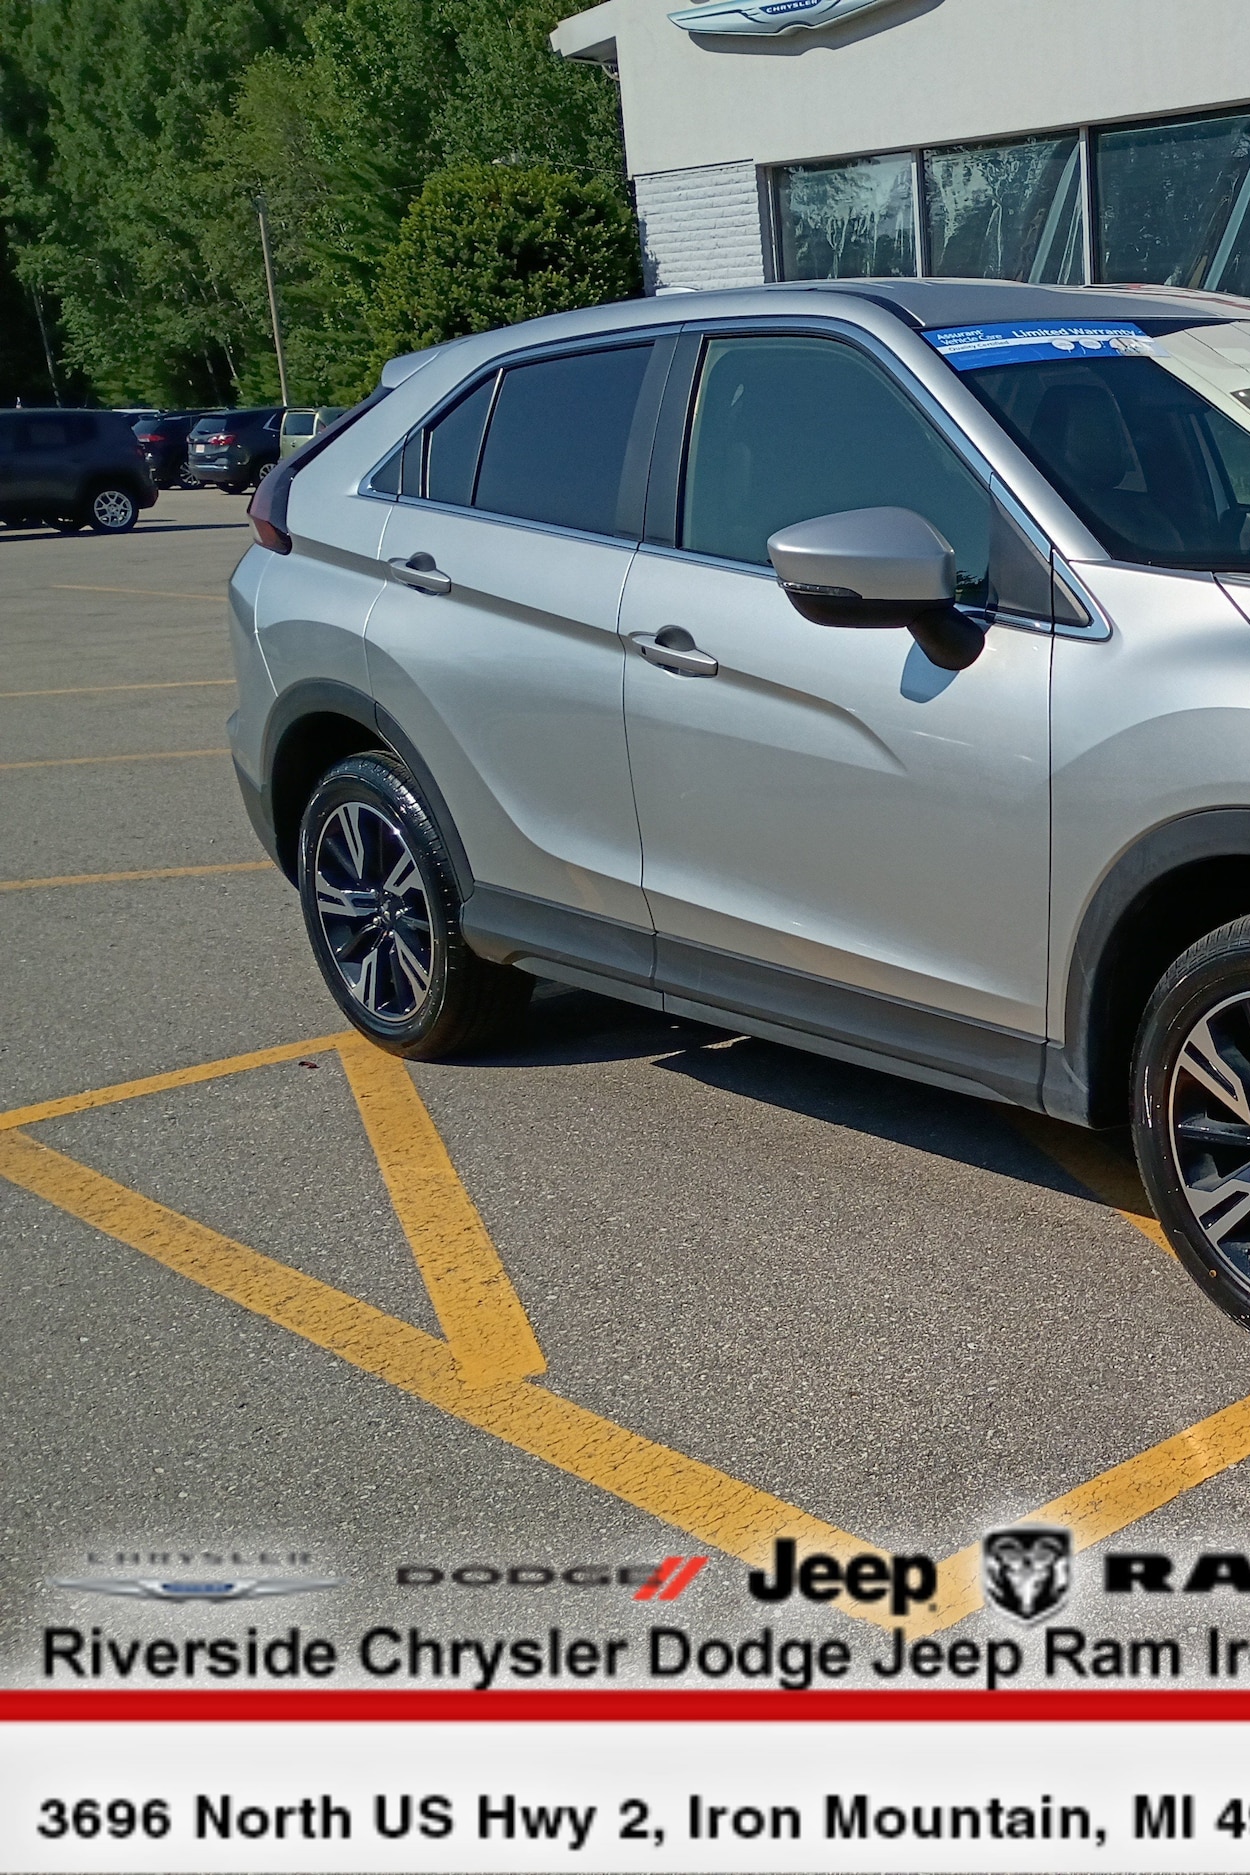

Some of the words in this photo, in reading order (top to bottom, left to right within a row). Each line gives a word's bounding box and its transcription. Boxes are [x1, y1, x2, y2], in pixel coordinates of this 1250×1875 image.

[766, 0, 818, 13] CHRYSLER
[937, 329, 984, 340] Assurant
[1012, 327, 1069, 338] Limited
[1069, 327, 1136, 337] Warranty
[940, 336, 979, 346] Vehicle
